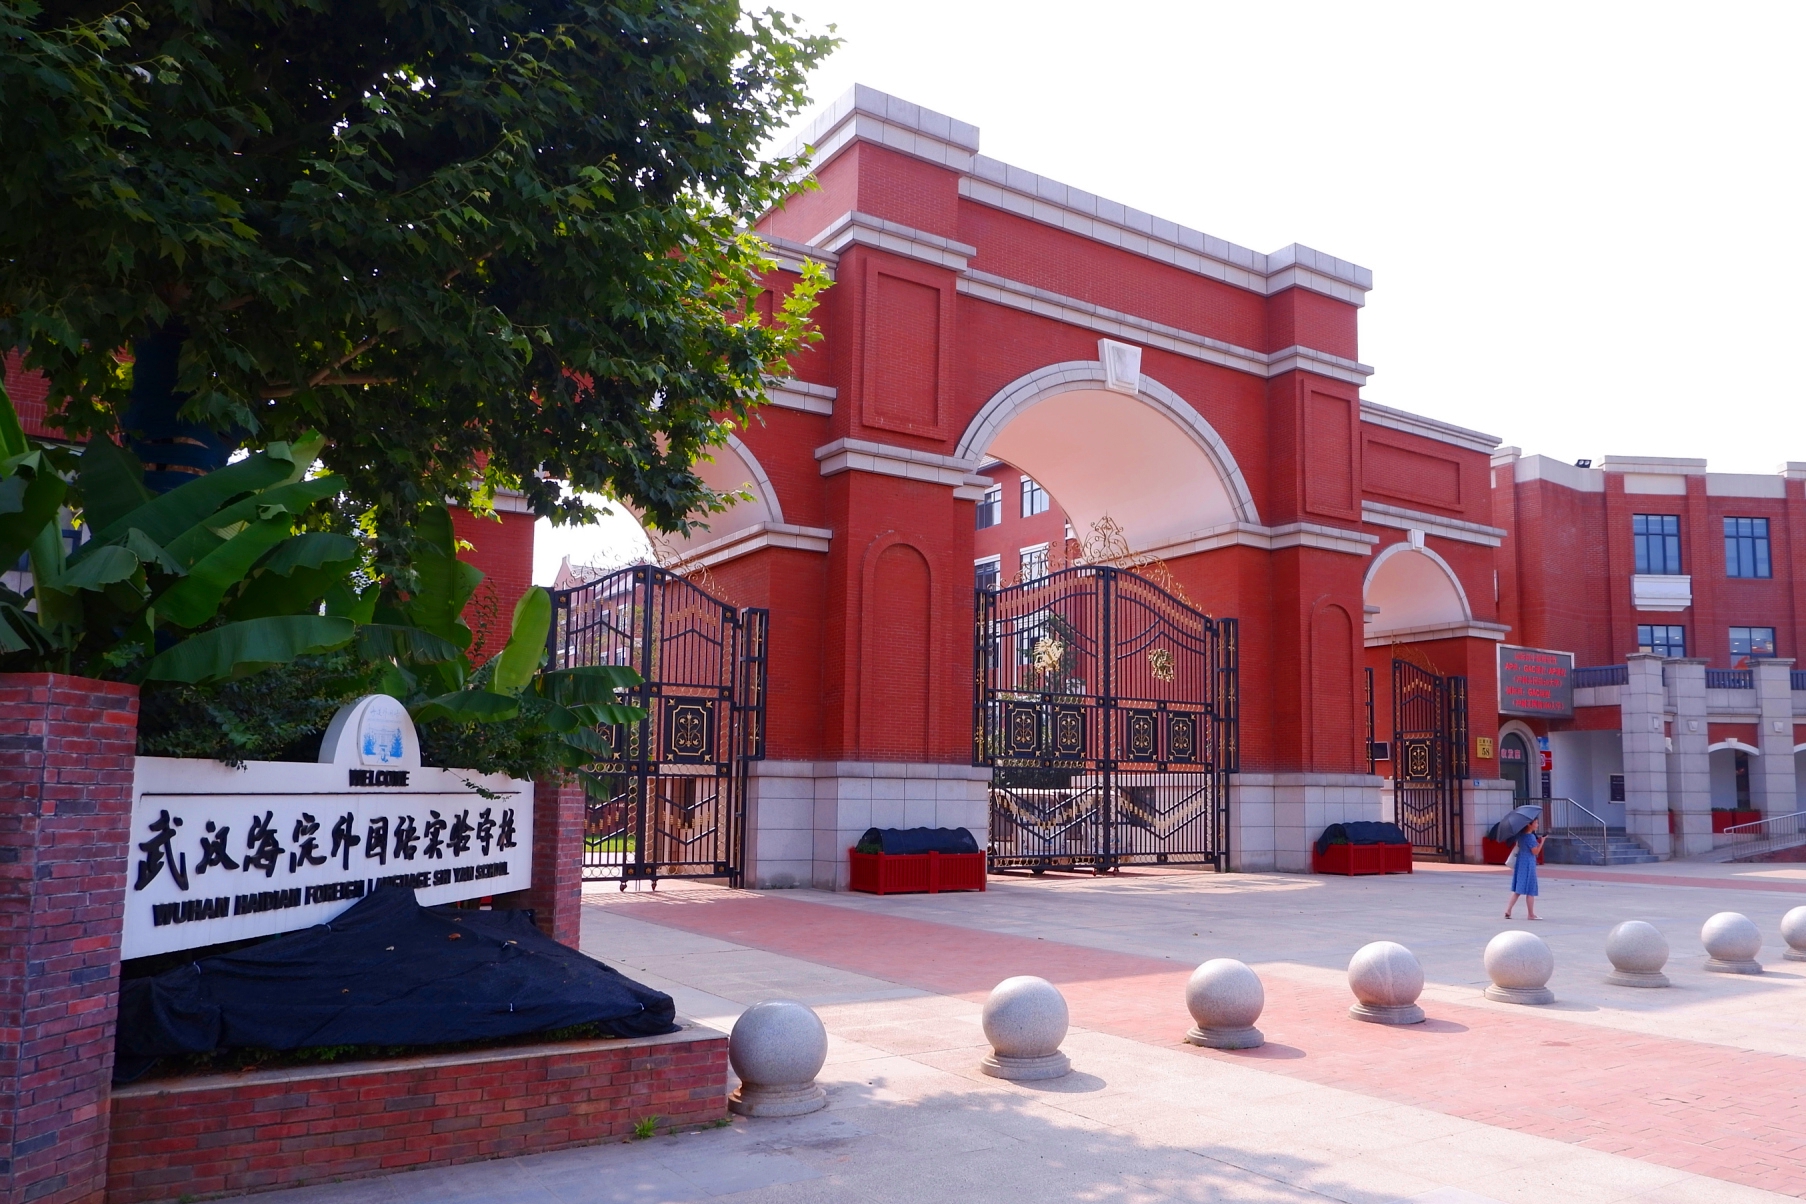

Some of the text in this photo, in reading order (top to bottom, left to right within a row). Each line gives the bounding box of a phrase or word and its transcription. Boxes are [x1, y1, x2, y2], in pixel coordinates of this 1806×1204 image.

[349, 769, 410, 787] WELCOME
[134, 808, 517, 891] 武汉海淀外国语实验学校
[152, 897, 230, 927] WUHAN
[234, 888, 302, 916] HAIDIAN
[304, 880, 365, 905] FOREIGN
[433, 868, 452, 887] SHI
[453, 866, 475, 883] YAN
[475, 862, 510, 880] SCHOOL
